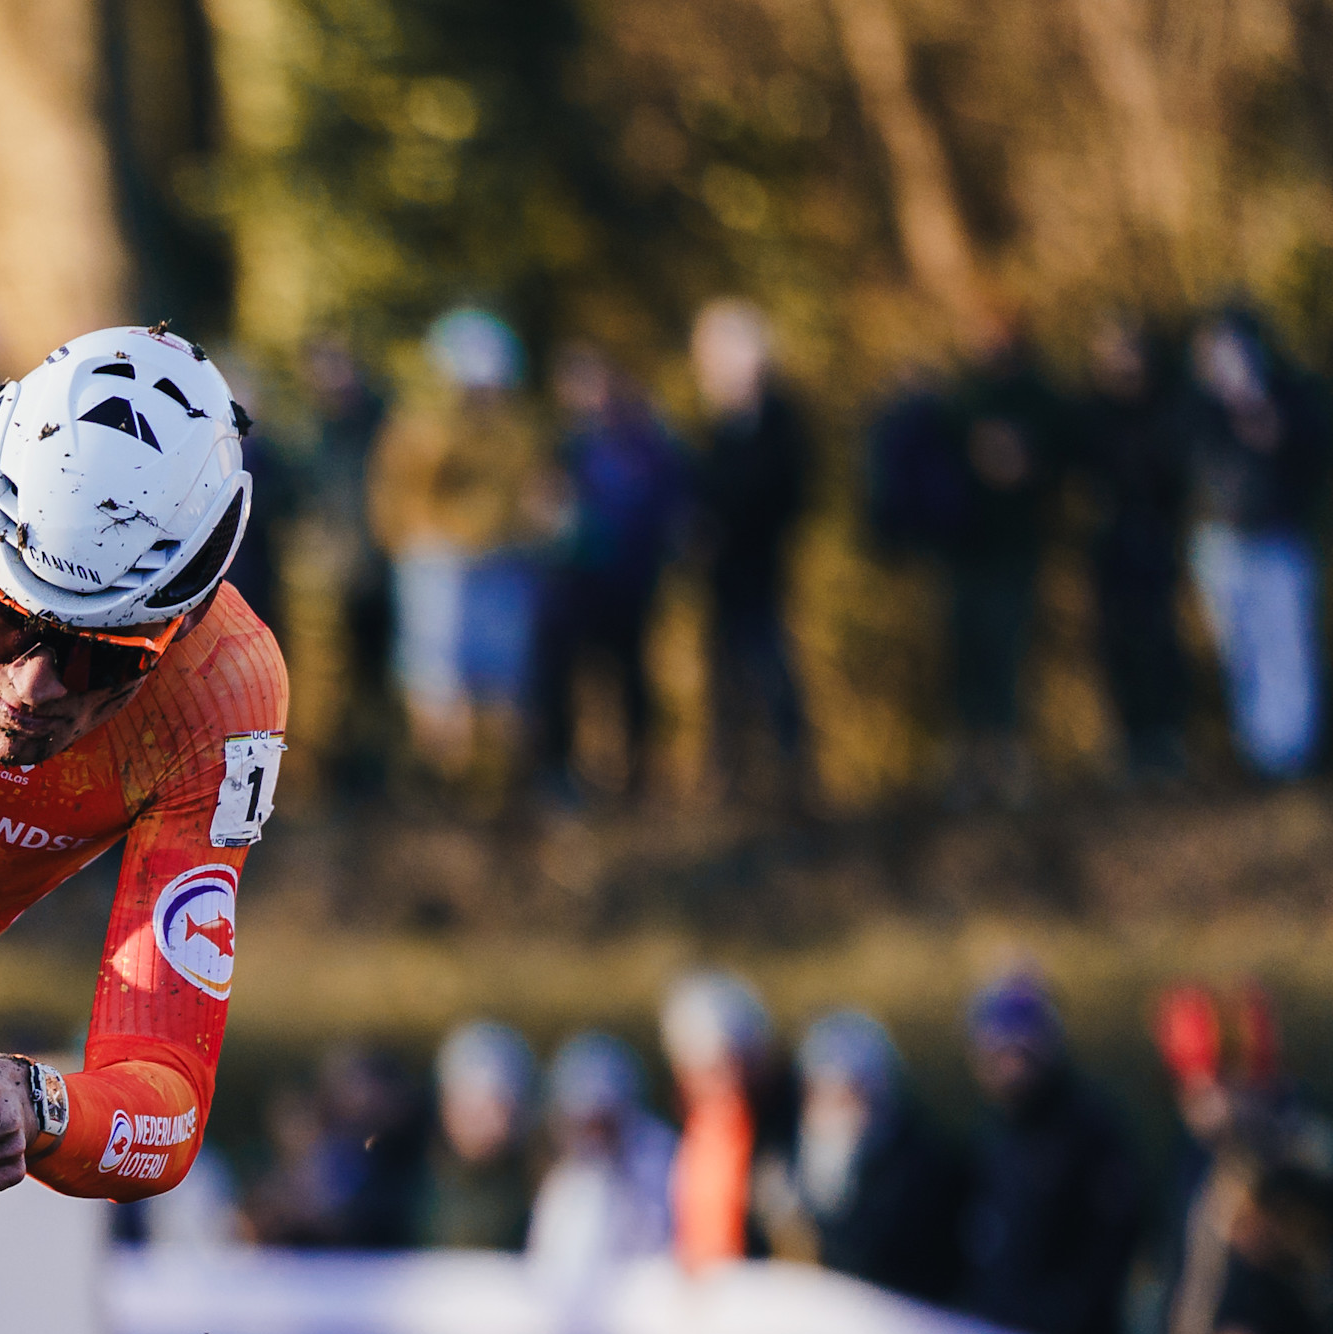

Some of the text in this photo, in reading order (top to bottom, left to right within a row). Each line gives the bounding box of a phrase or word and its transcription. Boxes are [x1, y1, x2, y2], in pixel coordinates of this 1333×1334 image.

[28, 544, 103, 586] CANYON
[252, 730, 269, 740] UCI
[245, 765, 265, 822] 1
[117, 1151, 169, 1179] LOTERIJ
